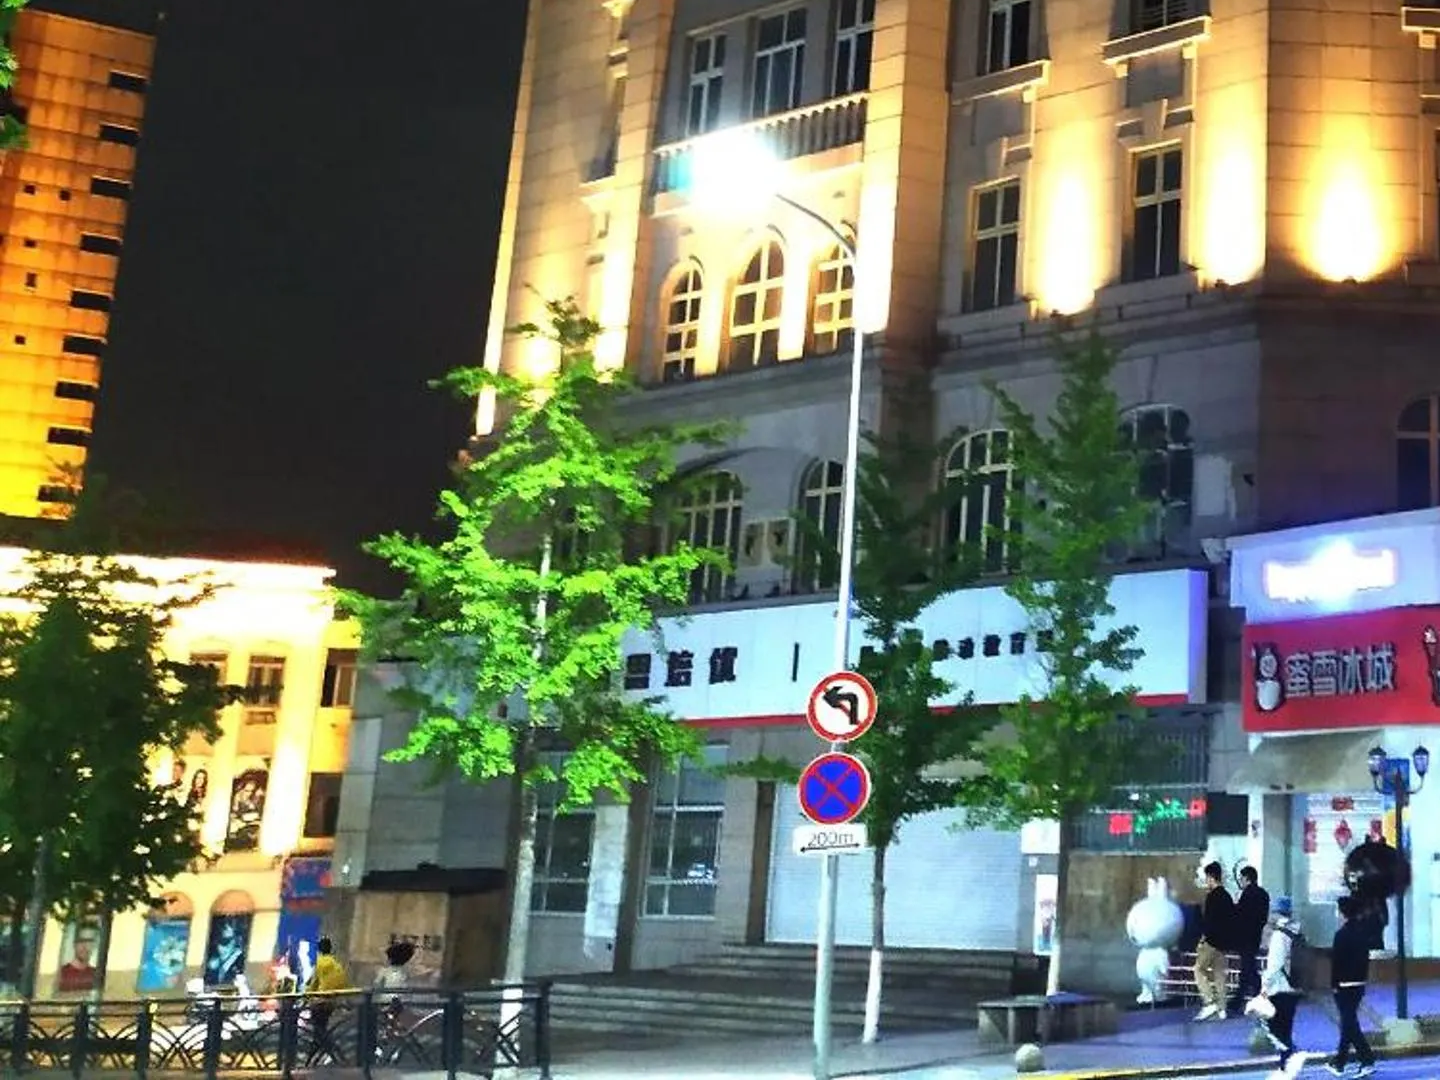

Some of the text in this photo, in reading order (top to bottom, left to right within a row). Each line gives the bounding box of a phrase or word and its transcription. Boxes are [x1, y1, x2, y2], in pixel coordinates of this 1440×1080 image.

[1284, 642, 1394, 699] 蜜雪冰城
[807, 831, 854, 848] 200m
